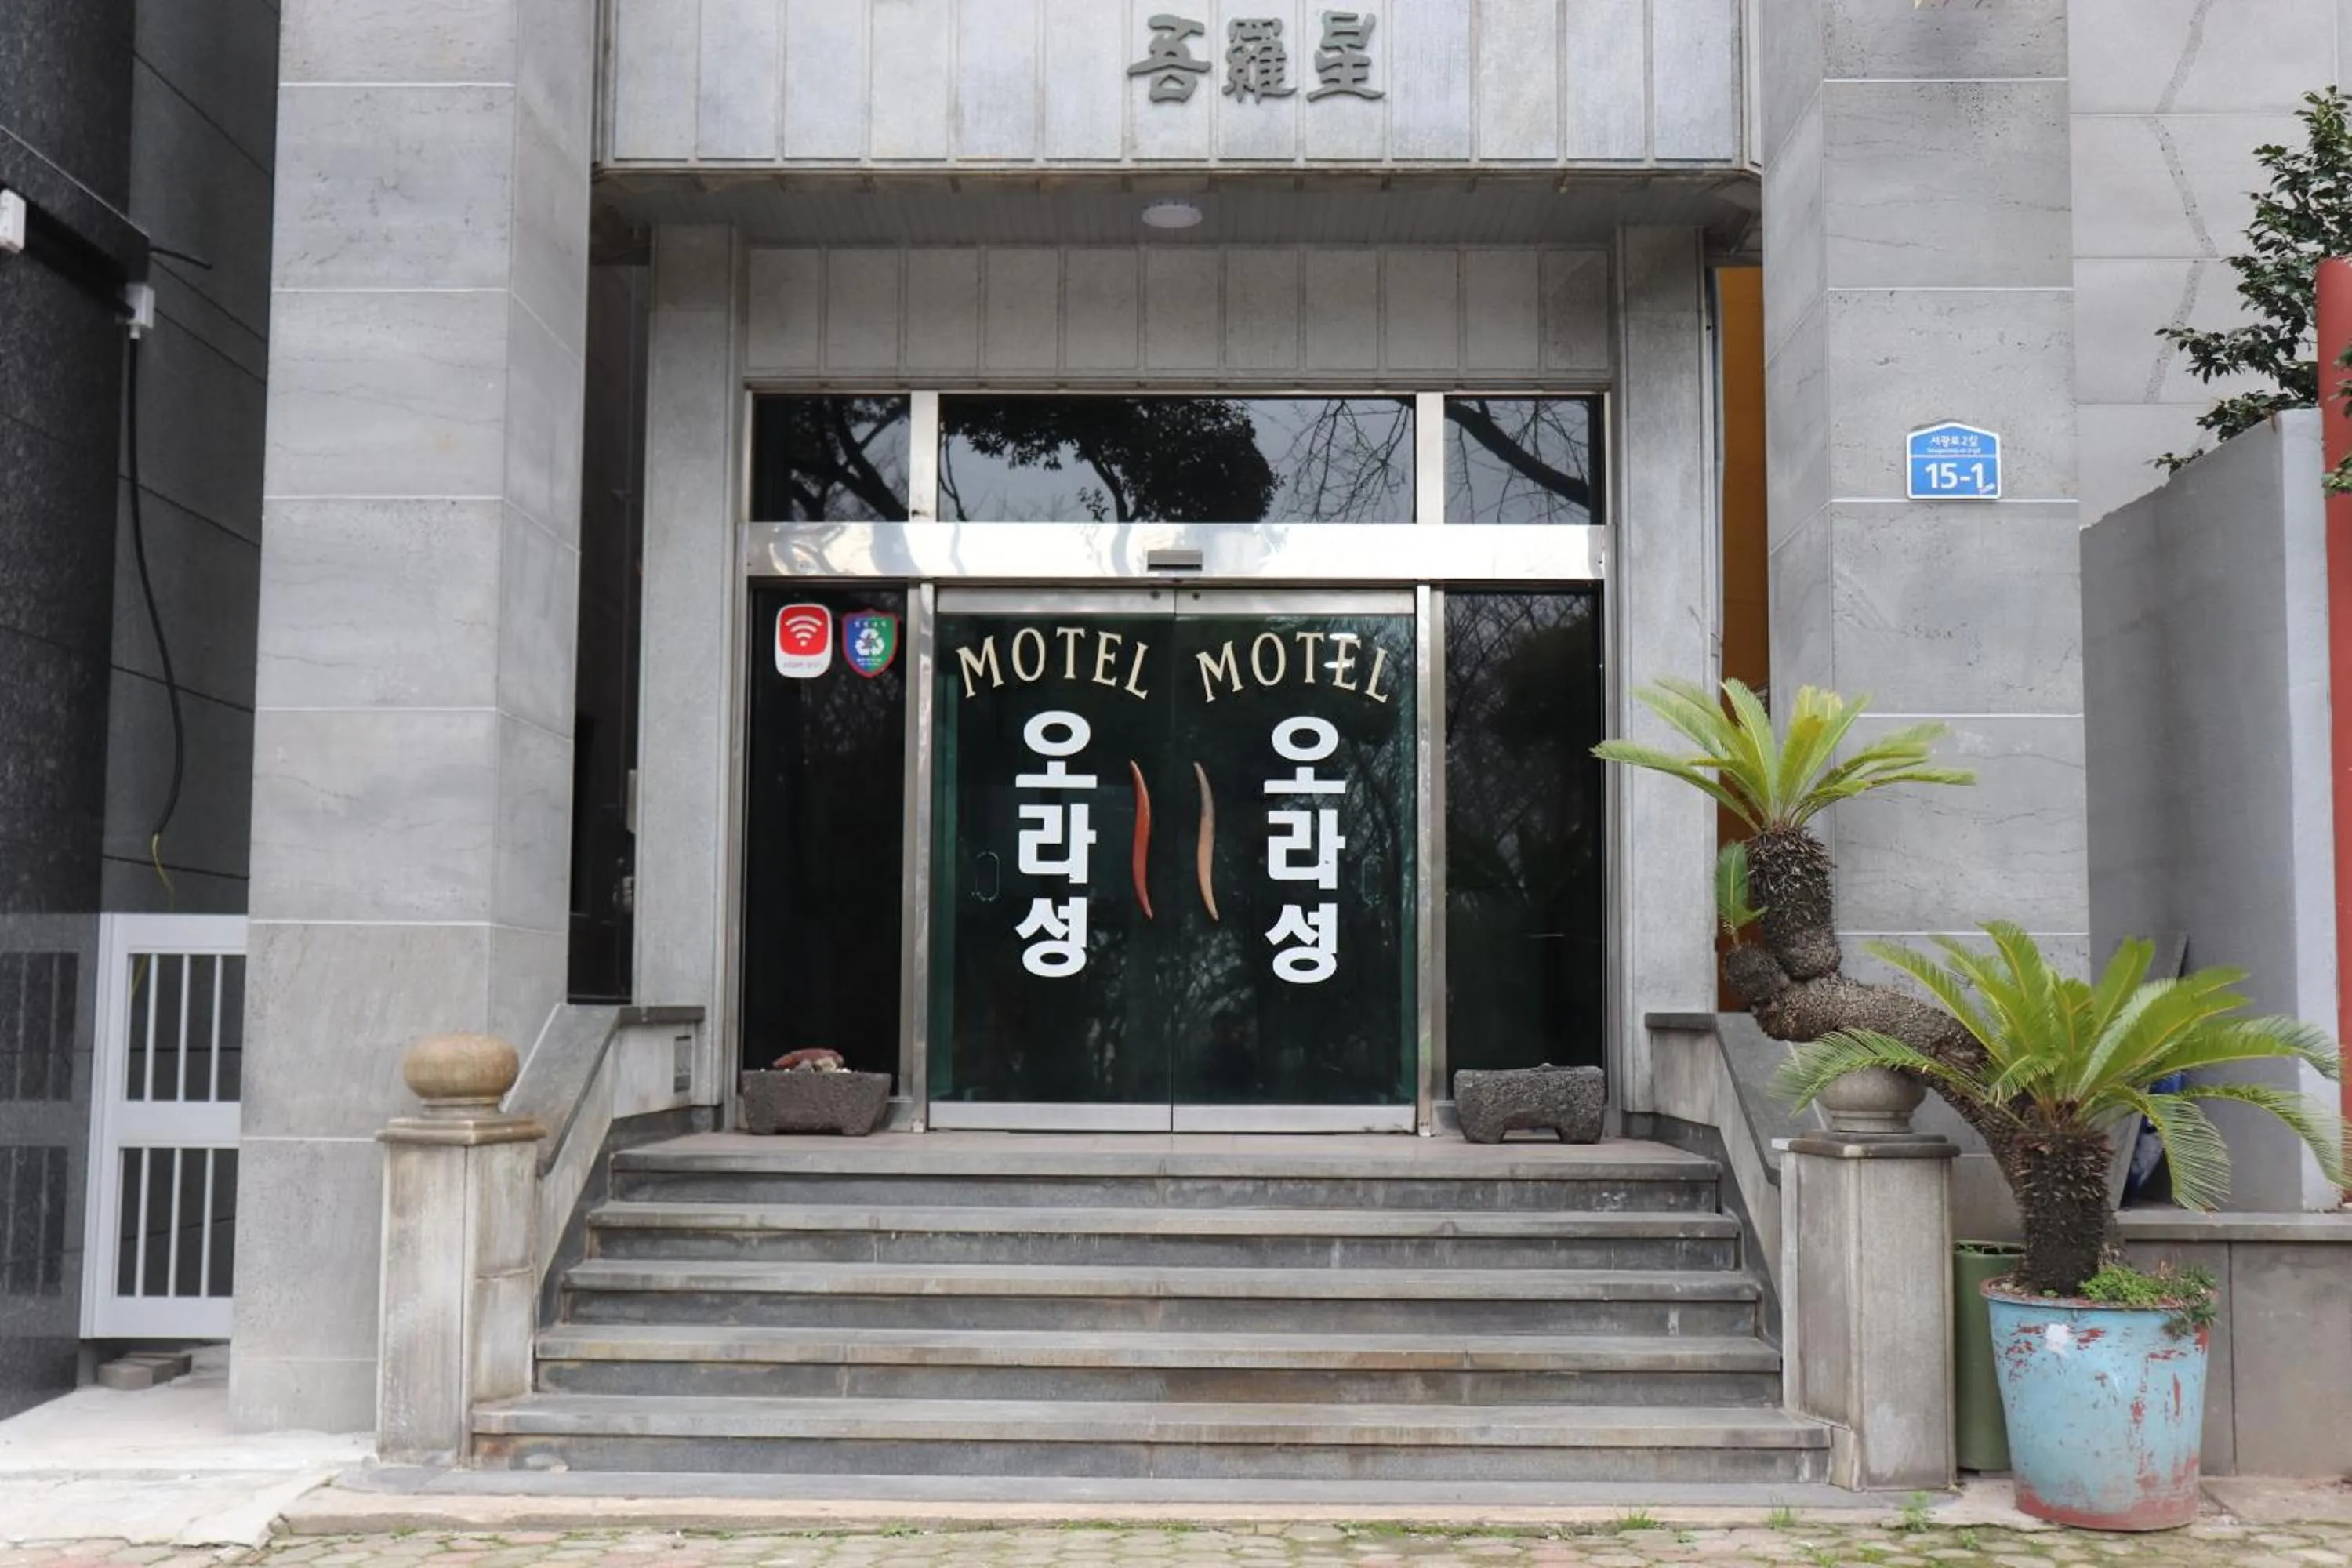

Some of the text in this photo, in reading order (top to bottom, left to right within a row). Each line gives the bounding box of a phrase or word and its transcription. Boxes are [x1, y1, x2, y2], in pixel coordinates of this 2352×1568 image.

[1925, 463, 1984, 489] 15-1
[956, 626, 1149, 699] MOTEL
[1196, 631, 1388, 703] MOTEL
[1015, 710, 1098, 978] 오라성
[1264, 716, 1346, 984] 오라성
